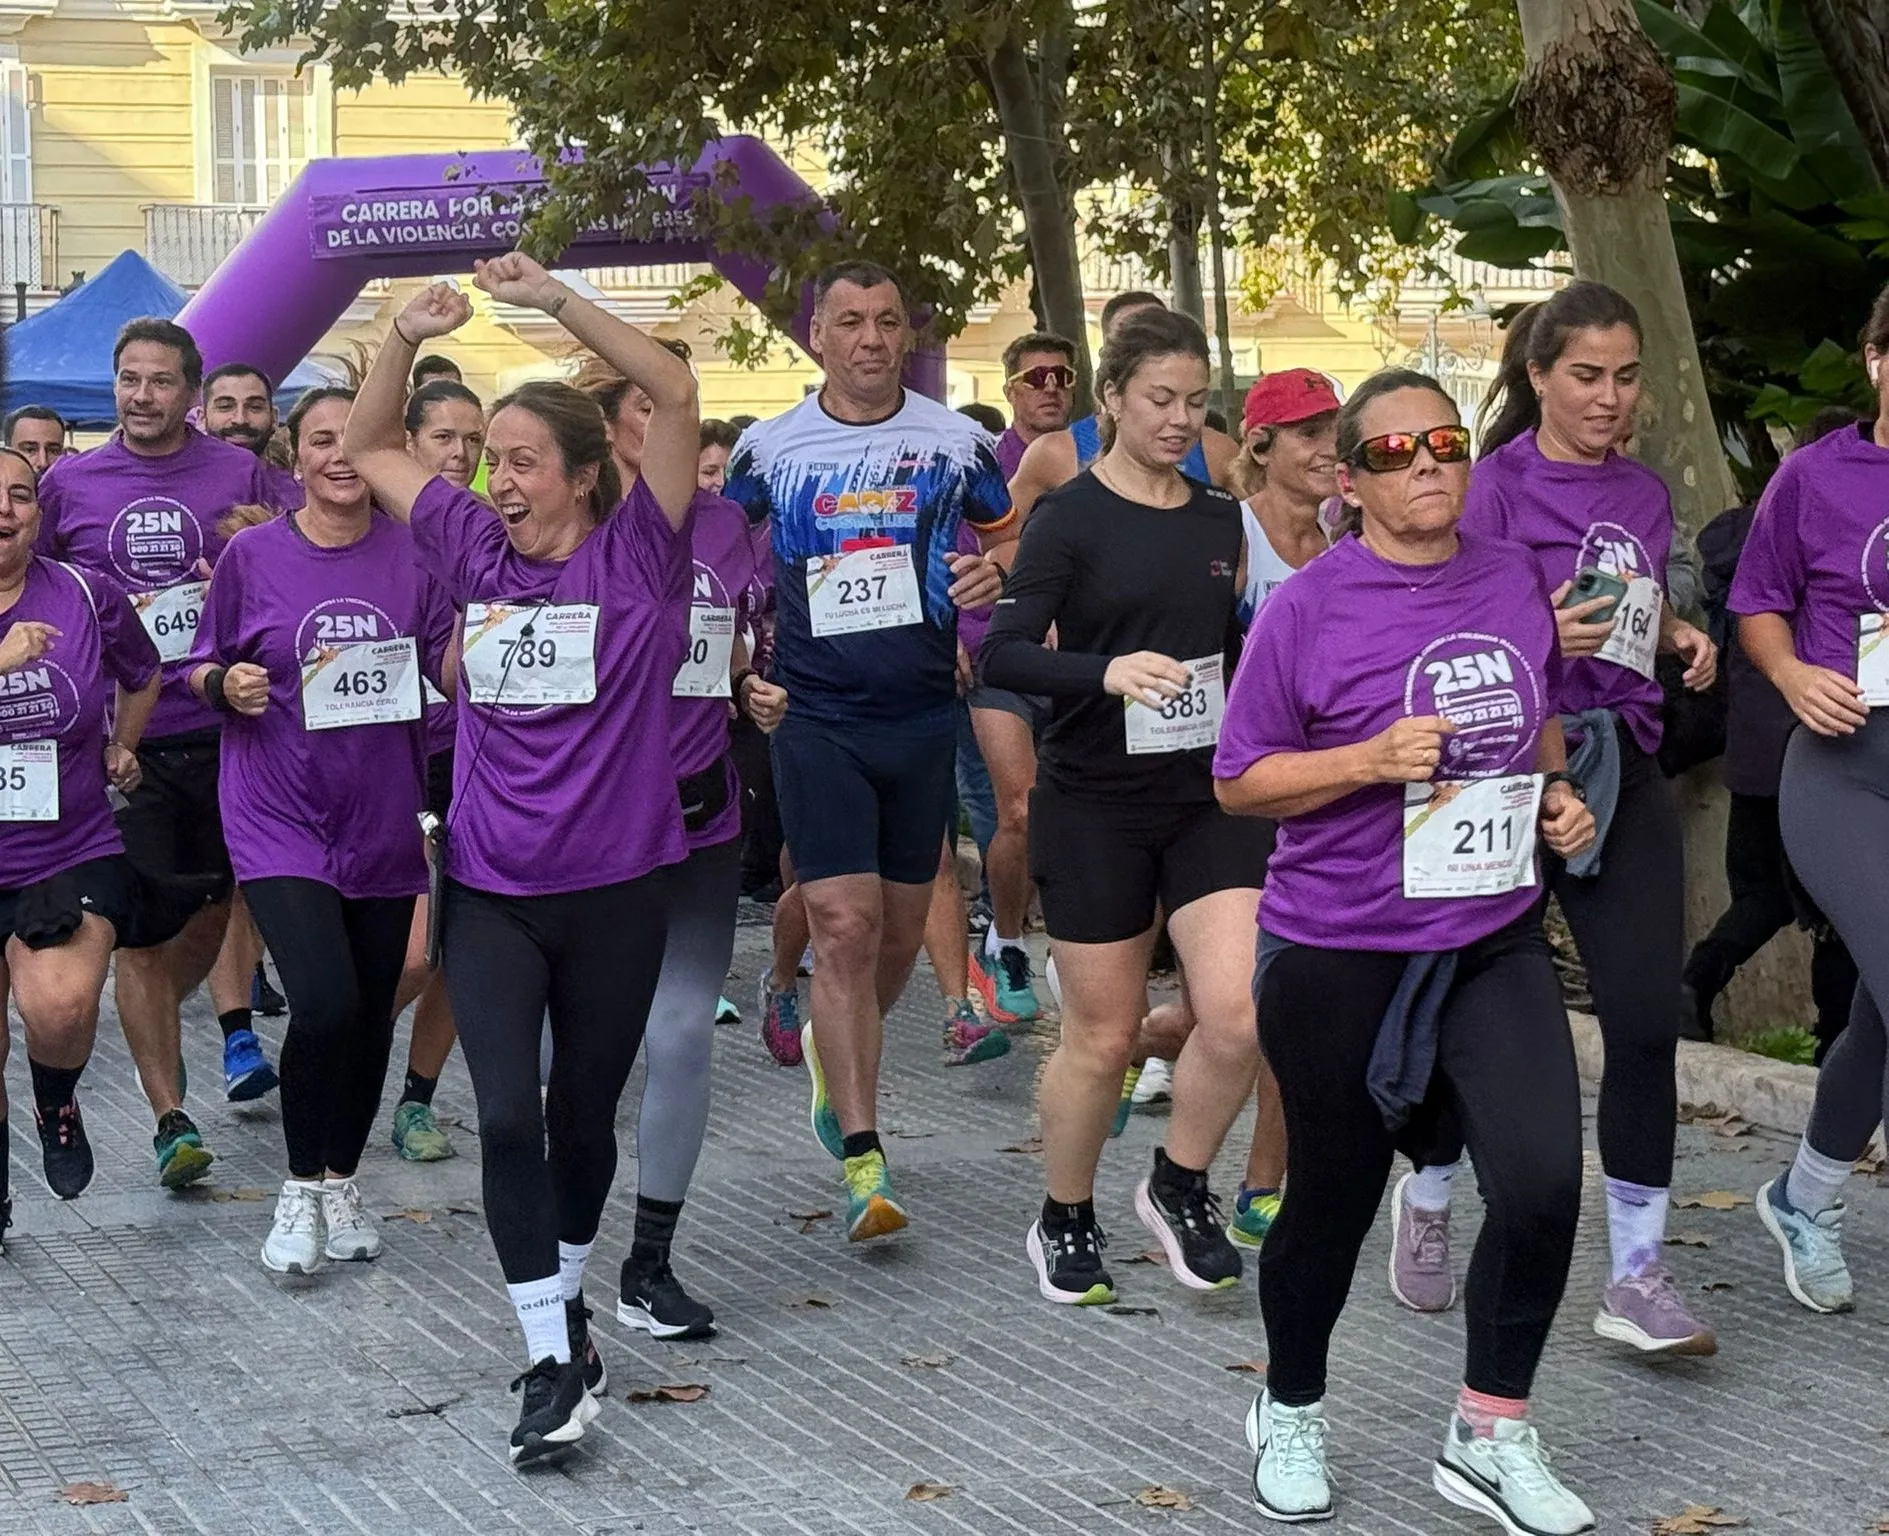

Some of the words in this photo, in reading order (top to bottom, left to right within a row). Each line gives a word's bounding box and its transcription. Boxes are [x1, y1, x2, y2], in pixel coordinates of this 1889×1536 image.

[341, 199, 440, 223] CARRERA
[448, 196, 494, 217] POR
[327, 228, 351, 248] DE
[353, 227, 380, 245] LA
[381, 222, 486, 244] VIOLENCIA
[126, 511, 182, 534] 25N
[1593, 536, 1638, 577] 5N
[837, 575, 887, 605] 237
[154, 608, 200, 637] 649
[315, 614, 379, 638] 25N
[546, 611, 592, 620] CARRERA
[1621, 602, 1652, 640] 164
[371, 643, 411, 655] CARRERA
[498, 638, 556, 669] 789
[333, 669, 388, 697] 463
[1424, 650, 1514, 695] 25N
[324, 700, 374, 711] TOLERANCIA
[1452, 815, 1513, 855] 211
[520, 1293, 565, 1310] adid
